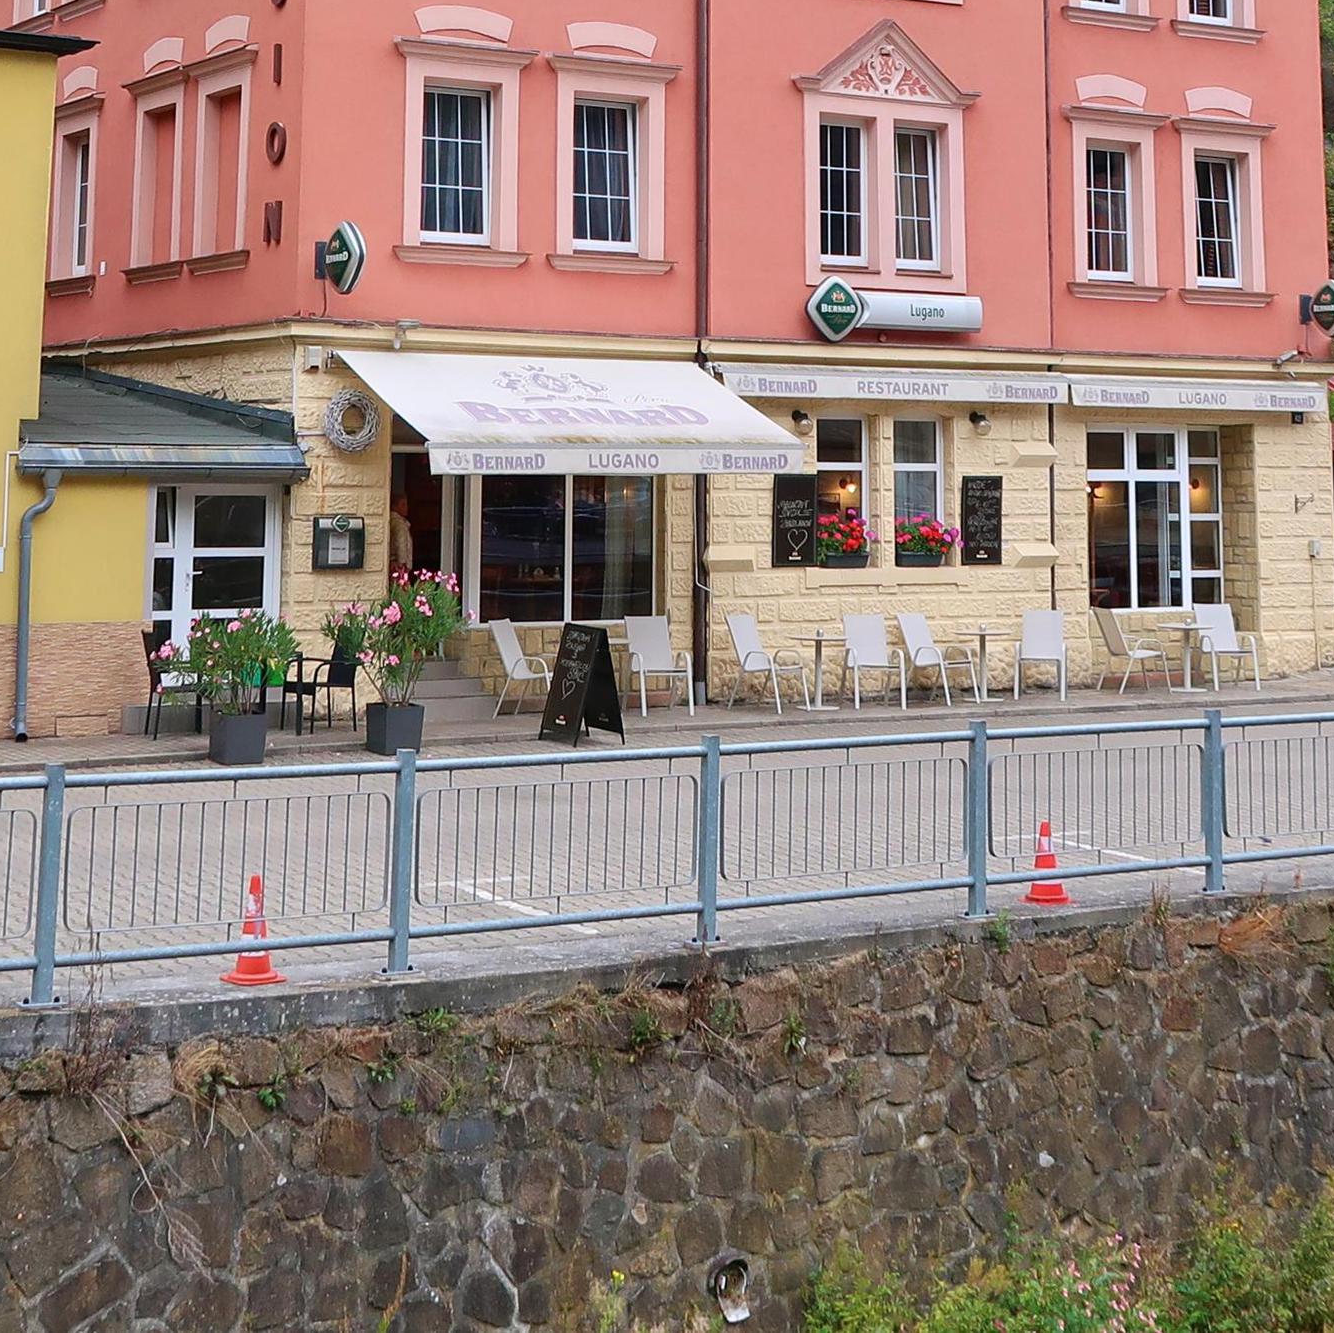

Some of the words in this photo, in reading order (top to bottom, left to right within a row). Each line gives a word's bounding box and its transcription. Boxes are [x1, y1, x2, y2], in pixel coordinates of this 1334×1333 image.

[821, 303, 855, 313] BERNARD
[910, 304, 945, 320] Lugano
[758, 378, 817, 394] BERNARD
[857, 381, 949, 396] RESTAURANT
[1005, 385, 1058, 399] BERNARD
[1101, 389, 1149, 404] BERNARD
[1179, 392, 1227, 405] LUGANO
[1270, 395, 1316, 409] BERNARD
[454, 401, 709, 425] BERNARD
[472, 453, 546, 470] BERNARD
[588, 453, 659, 469] LUGANO
[722, 453, 788, 469] BERNARD
